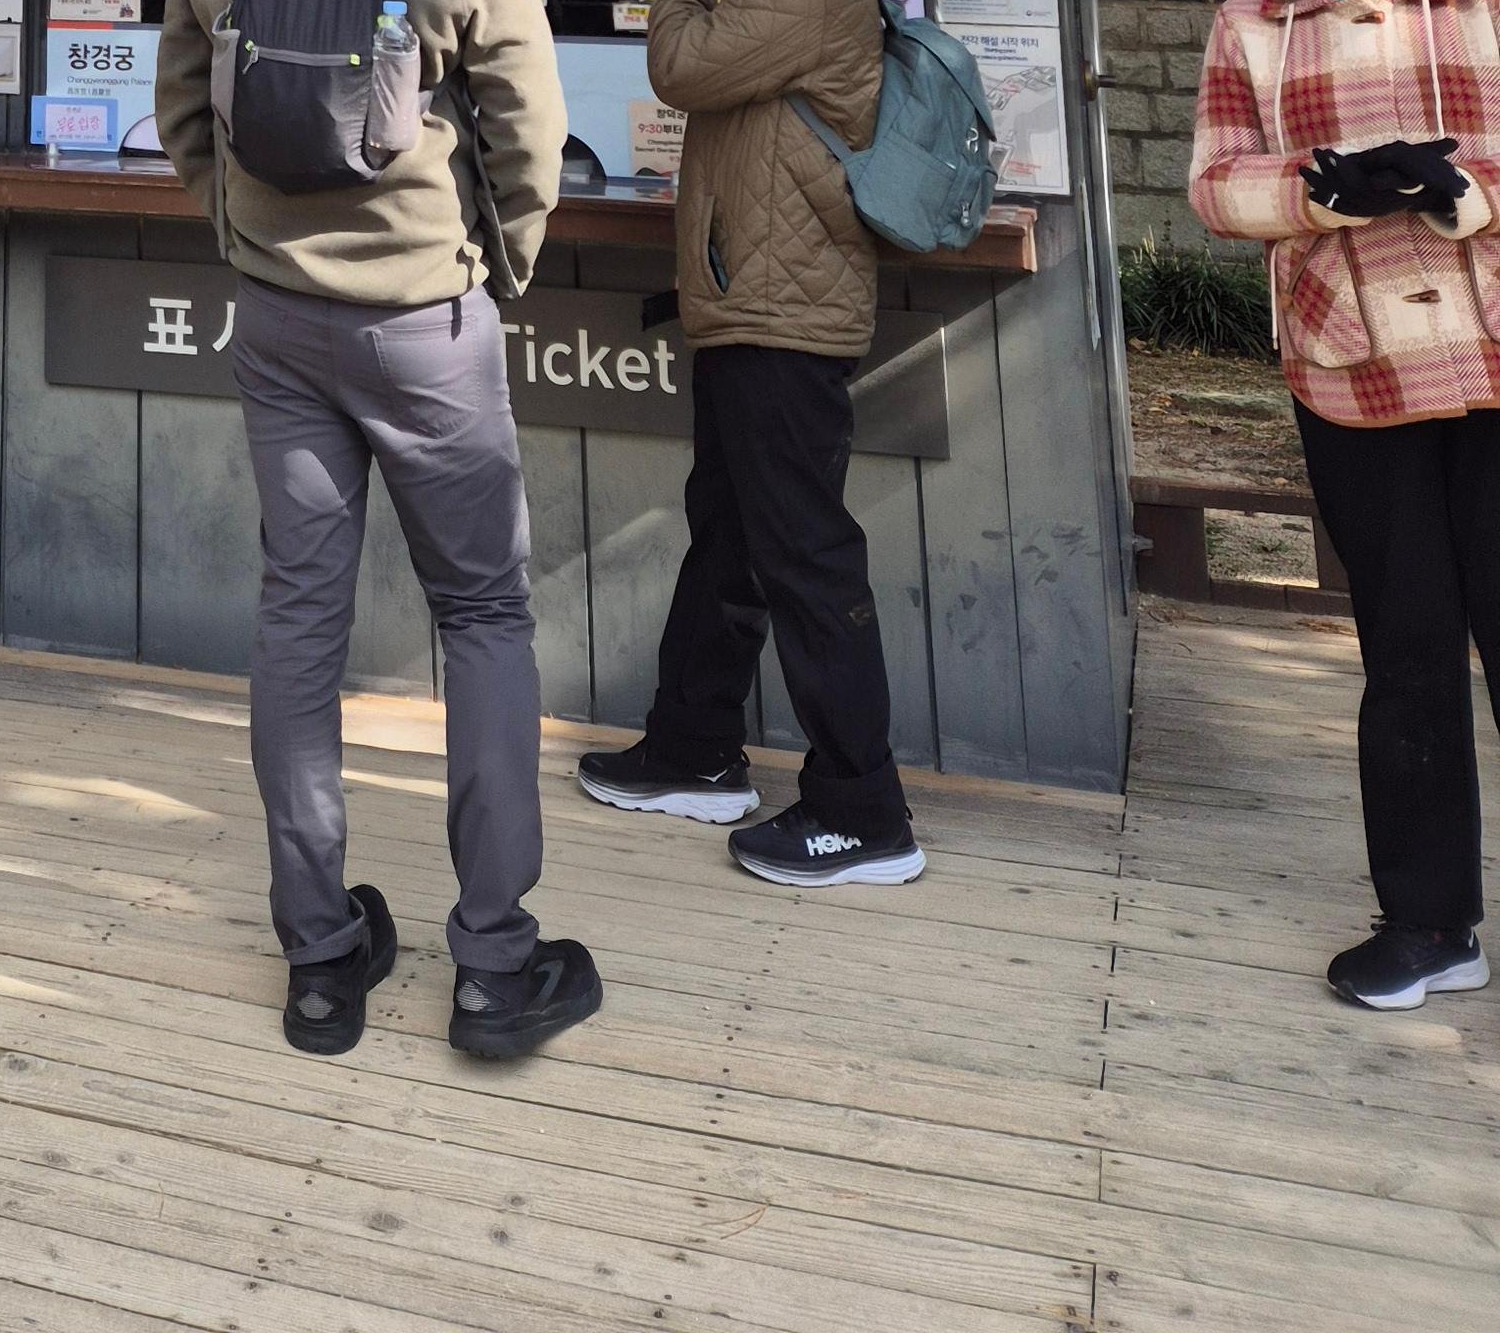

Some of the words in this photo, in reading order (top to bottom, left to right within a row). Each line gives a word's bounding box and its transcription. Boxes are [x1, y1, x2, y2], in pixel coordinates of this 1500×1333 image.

[67, 43, 136, 72] 창경궁
[143, 297, 198, 355] 표
[500, 322, 677, 394] Ticket
[805, 833, 863, 857] HOKA
